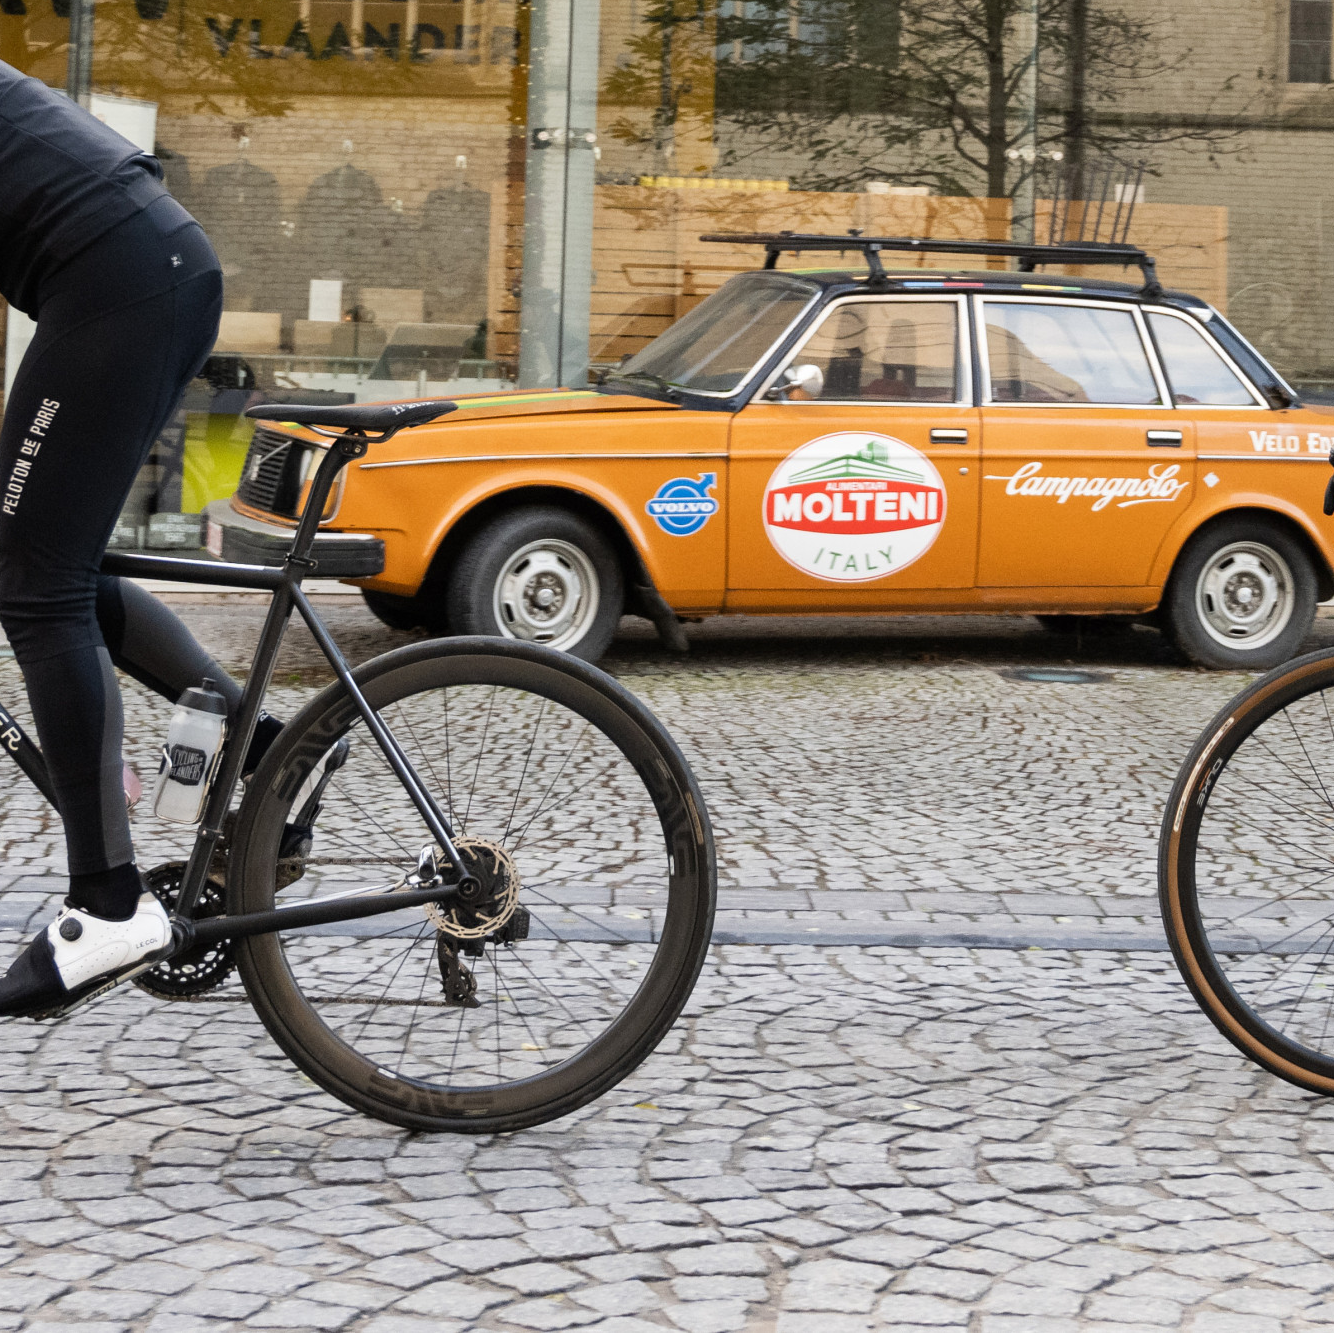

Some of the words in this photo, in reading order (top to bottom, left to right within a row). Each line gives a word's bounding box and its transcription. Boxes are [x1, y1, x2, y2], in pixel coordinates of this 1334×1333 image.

[29, 398, 61, 437] PARIS
[20, 438, 42, 457] DE
[1248, 430, 1300, 453] VELO
[2, 458, 33, 515] PELOTON
[825, 481, 888, 492] ALIMENTARI
[984, 461, 1189, 512] Campagnolo
[650, 501, 715, 514] VOLVO
[773, 491, 938, 523] MOLTENI
[813, 545, 894, 572] ITALY
